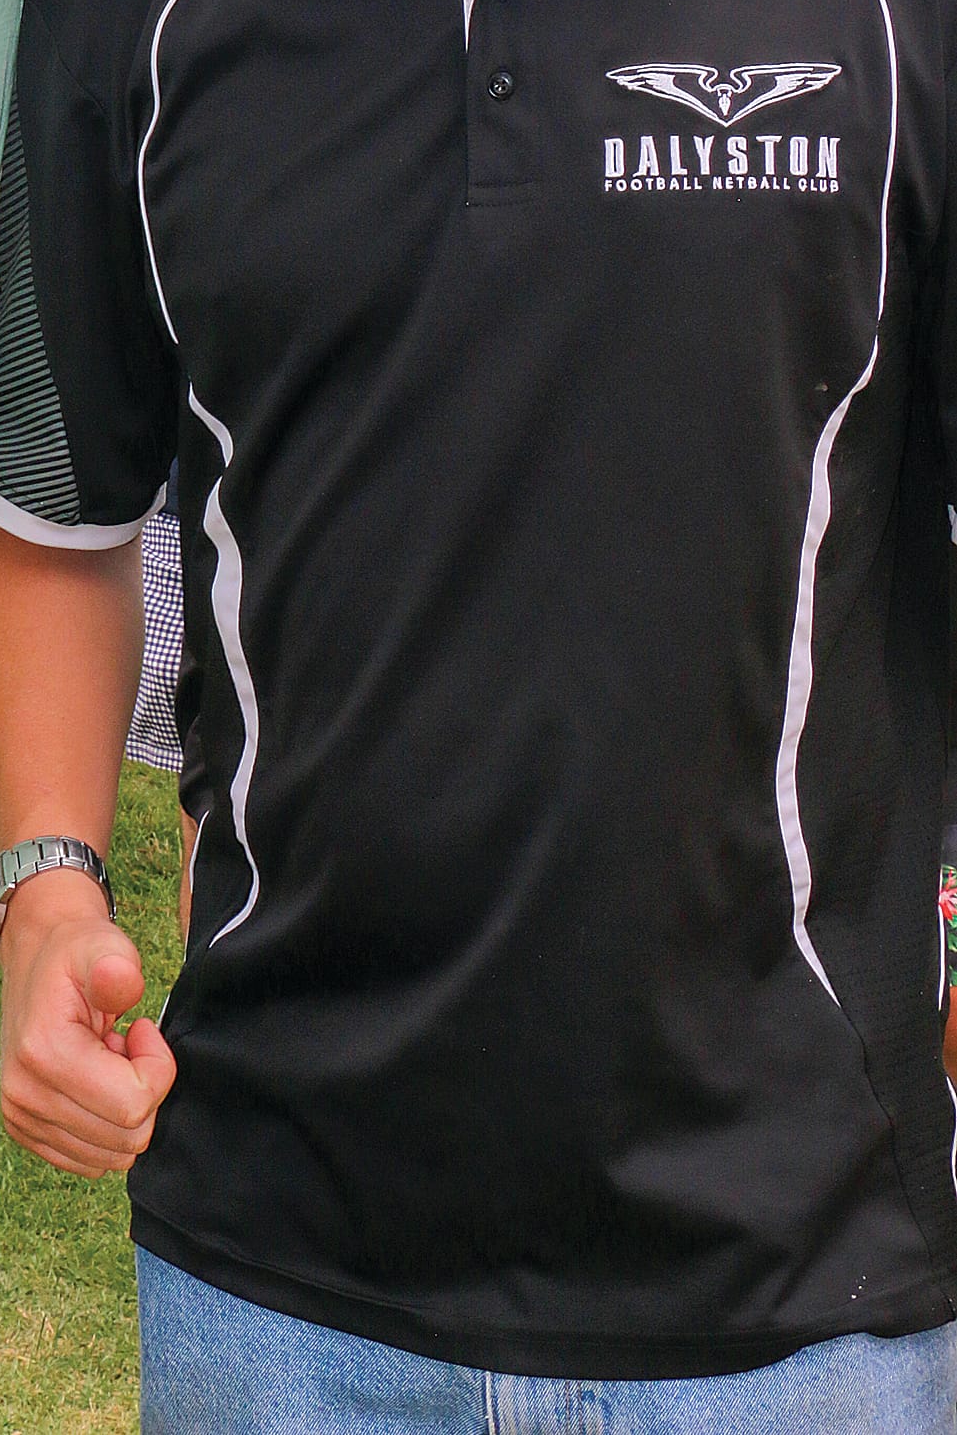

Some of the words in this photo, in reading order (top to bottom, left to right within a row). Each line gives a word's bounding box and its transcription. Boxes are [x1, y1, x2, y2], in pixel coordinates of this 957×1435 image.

[604, 134, 841, 179] DALYSTON
[604, 176, 703, 192] FOOTBALL
[712, 176, 791, 190] NETBALL
[798, 177, 839, 193] CLUB
